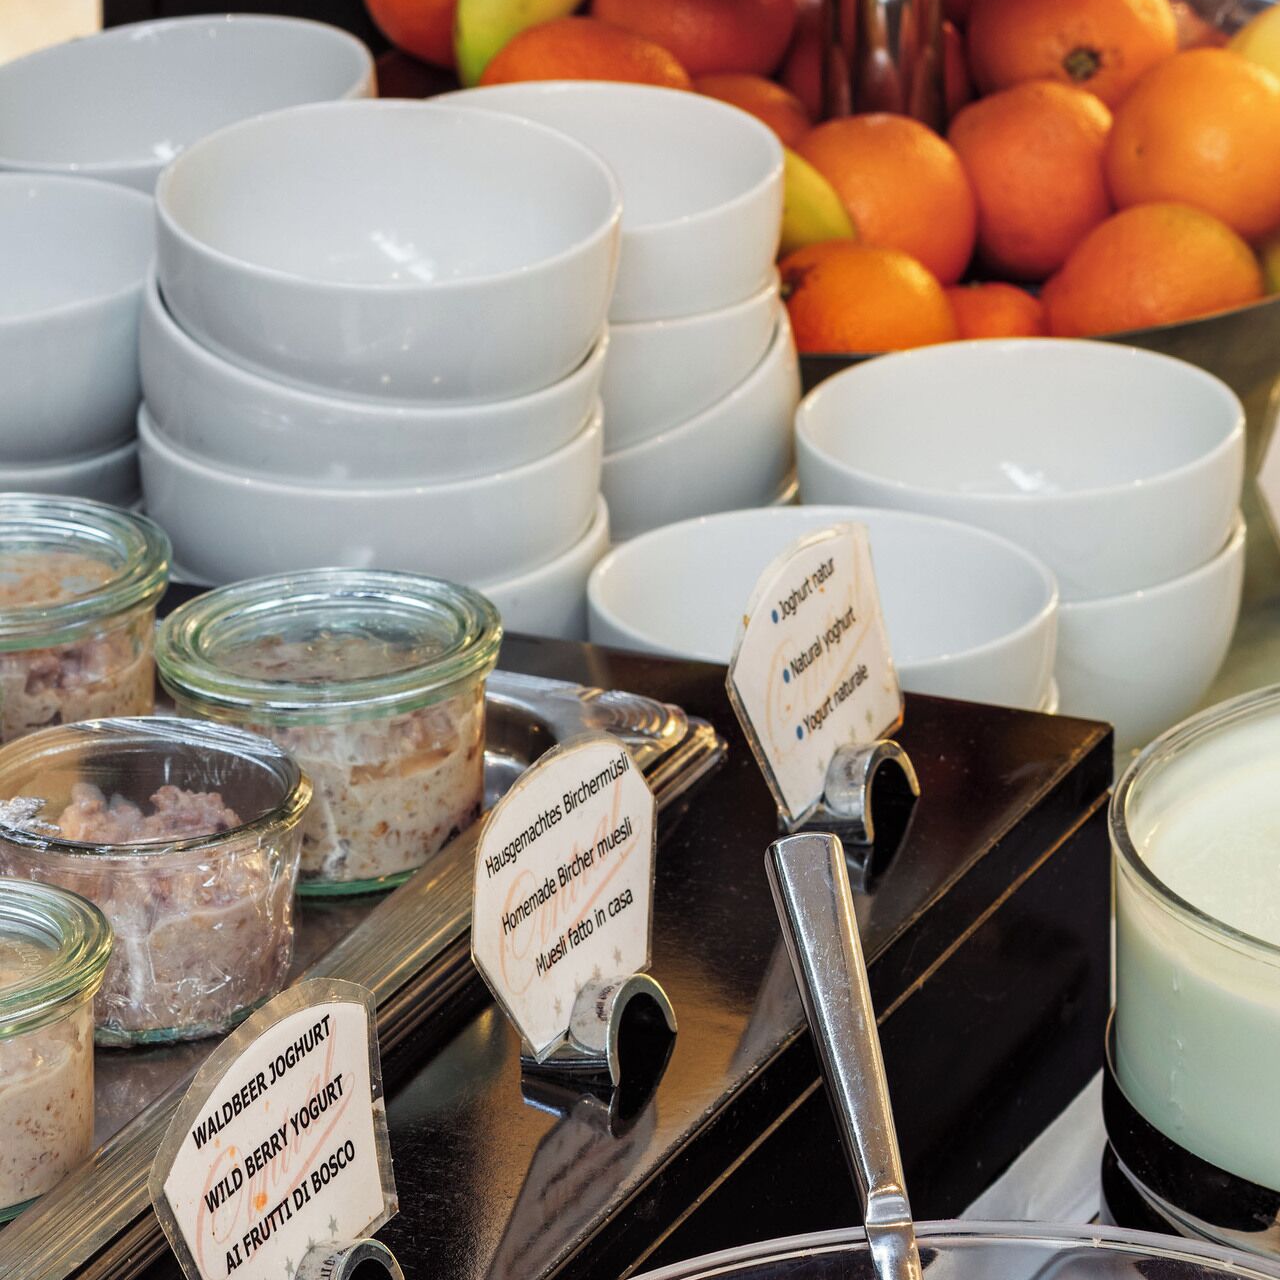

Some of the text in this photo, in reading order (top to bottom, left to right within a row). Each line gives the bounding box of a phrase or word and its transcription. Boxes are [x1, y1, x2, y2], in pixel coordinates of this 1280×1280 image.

[778, 557, 835, 620] Joghurt natur
[789, 605, 857, 679] Natural yoghurt
[802, 663, 870, 733] Yogurt naturale
[485, 751, 631, 879] Hausgemachtes Birchermüsli
[501, 816, 633, 936] Homemade Bircher muesli
[535, 886, 634, 977] Muesli fatto in casa
[192, 1014, 331, 1150] WALDBEER JOGHURT
[204, 1073, 345, 1215] WILD BERRY YOGURT
[225, 1138, 356, 1275] AI FRUTTI DI BOSCO
